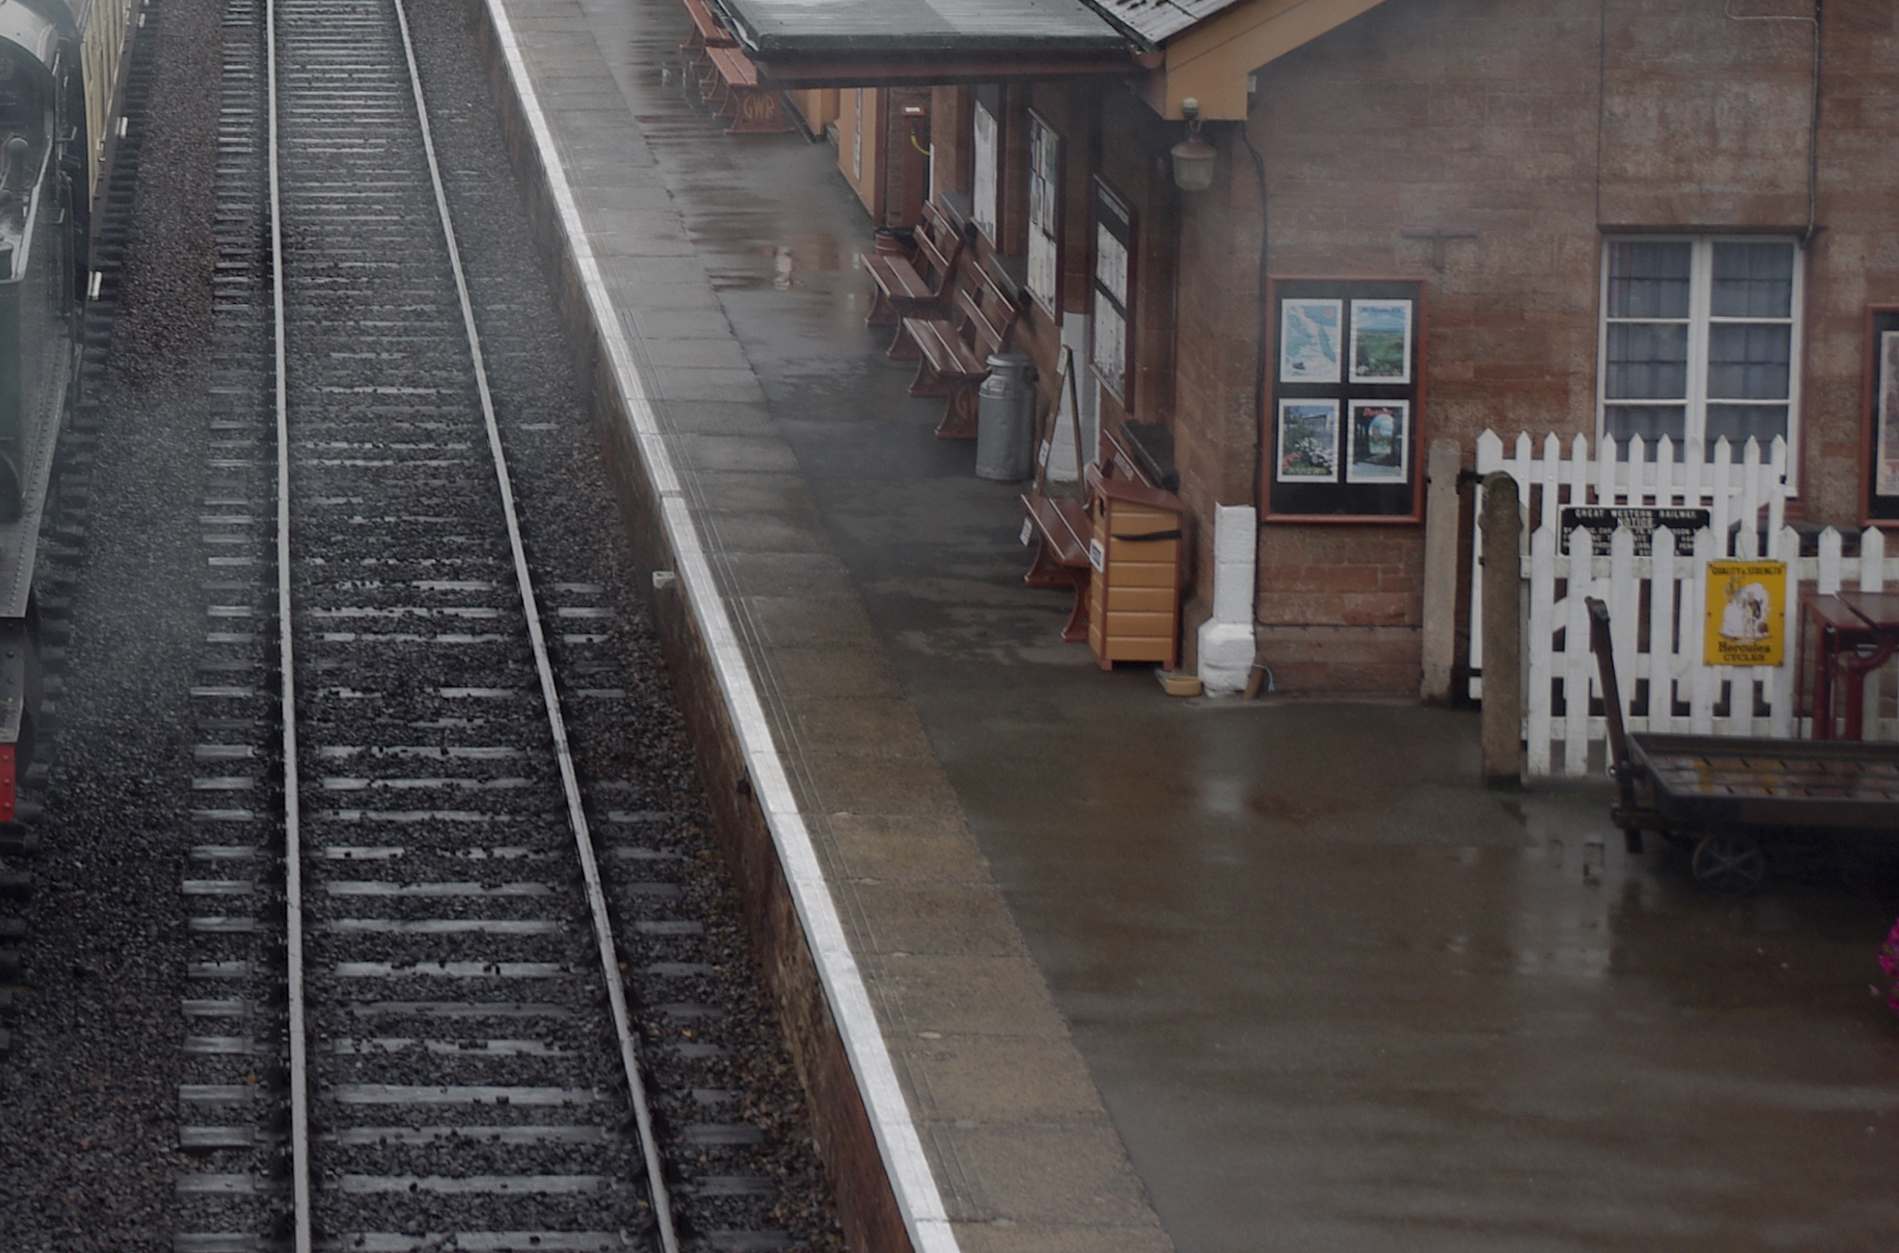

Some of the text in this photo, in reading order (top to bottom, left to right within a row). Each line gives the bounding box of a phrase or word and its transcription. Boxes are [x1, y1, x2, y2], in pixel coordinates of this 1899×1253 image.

[743, 95, 774, 120] GWR
[1575, 510, 1604, 518] GREAT
[1610, 510, 1652, 518] WESTERN
[1712, 567, 1740, 575] QUALITY
[1719, 642, 1771, 653] Hercules
